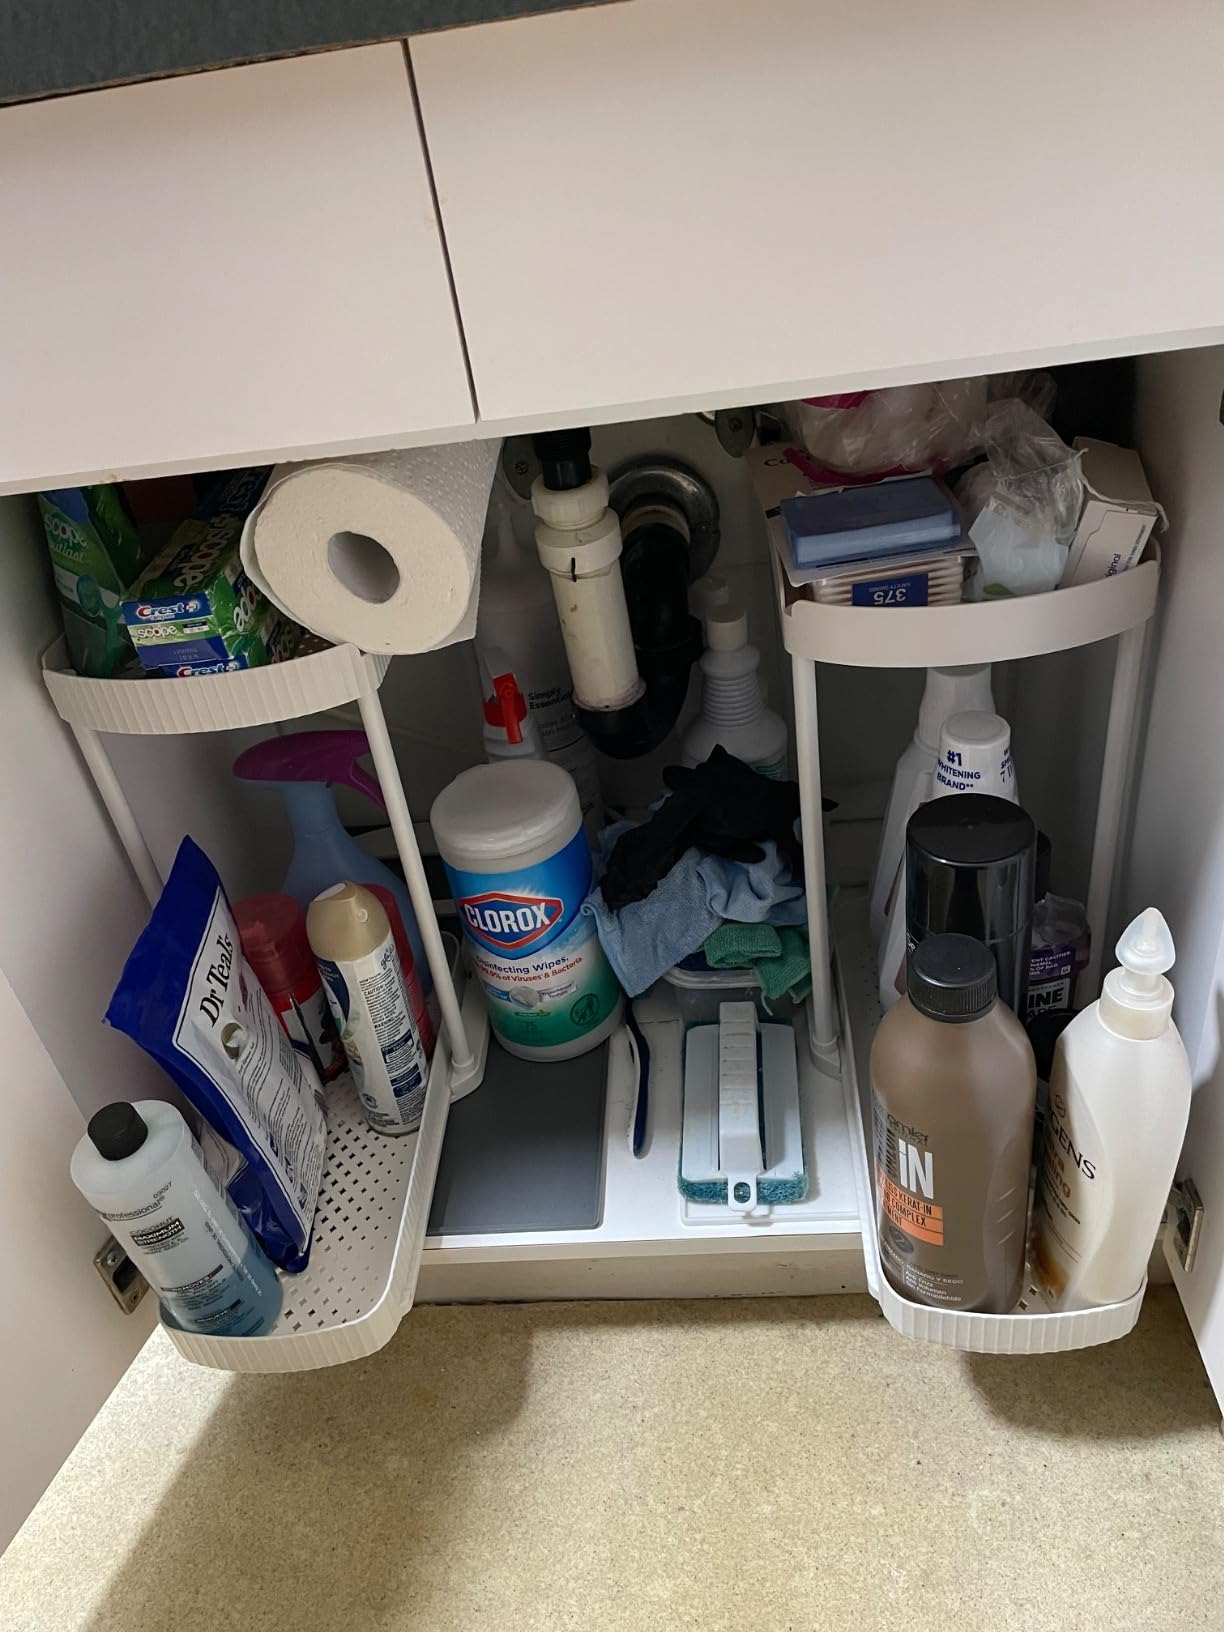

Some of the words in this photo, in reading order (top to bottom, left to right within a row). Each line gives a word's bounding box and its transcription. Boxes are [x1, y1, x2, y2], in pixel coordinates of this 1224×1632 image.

[873, 588, 907, 605] 375
[136, 602, 185, 618] Crest
[138, 624, 177, 639] scope
[177, 662, 224, 678] Crest
[946, 749, 962, 766] #1
[464, 902, 551, 933] CLOROX
[206, 934, 235, 987] Teal's
[551, 957, 582, 977] Bacteria
[200, 984, 223, 1028] Dr
[1028, 987, 1064, 1009] INE
[1050, 1110, 1097, 1180] GENS
[891, 1197, 926, 1227] COMPLEX
[130, 1216, 174, 1235] COCONUT
[134, 1220, 180, 1241] MAXIMUM
[137, 1225, 182, 1245] TRENGTH
